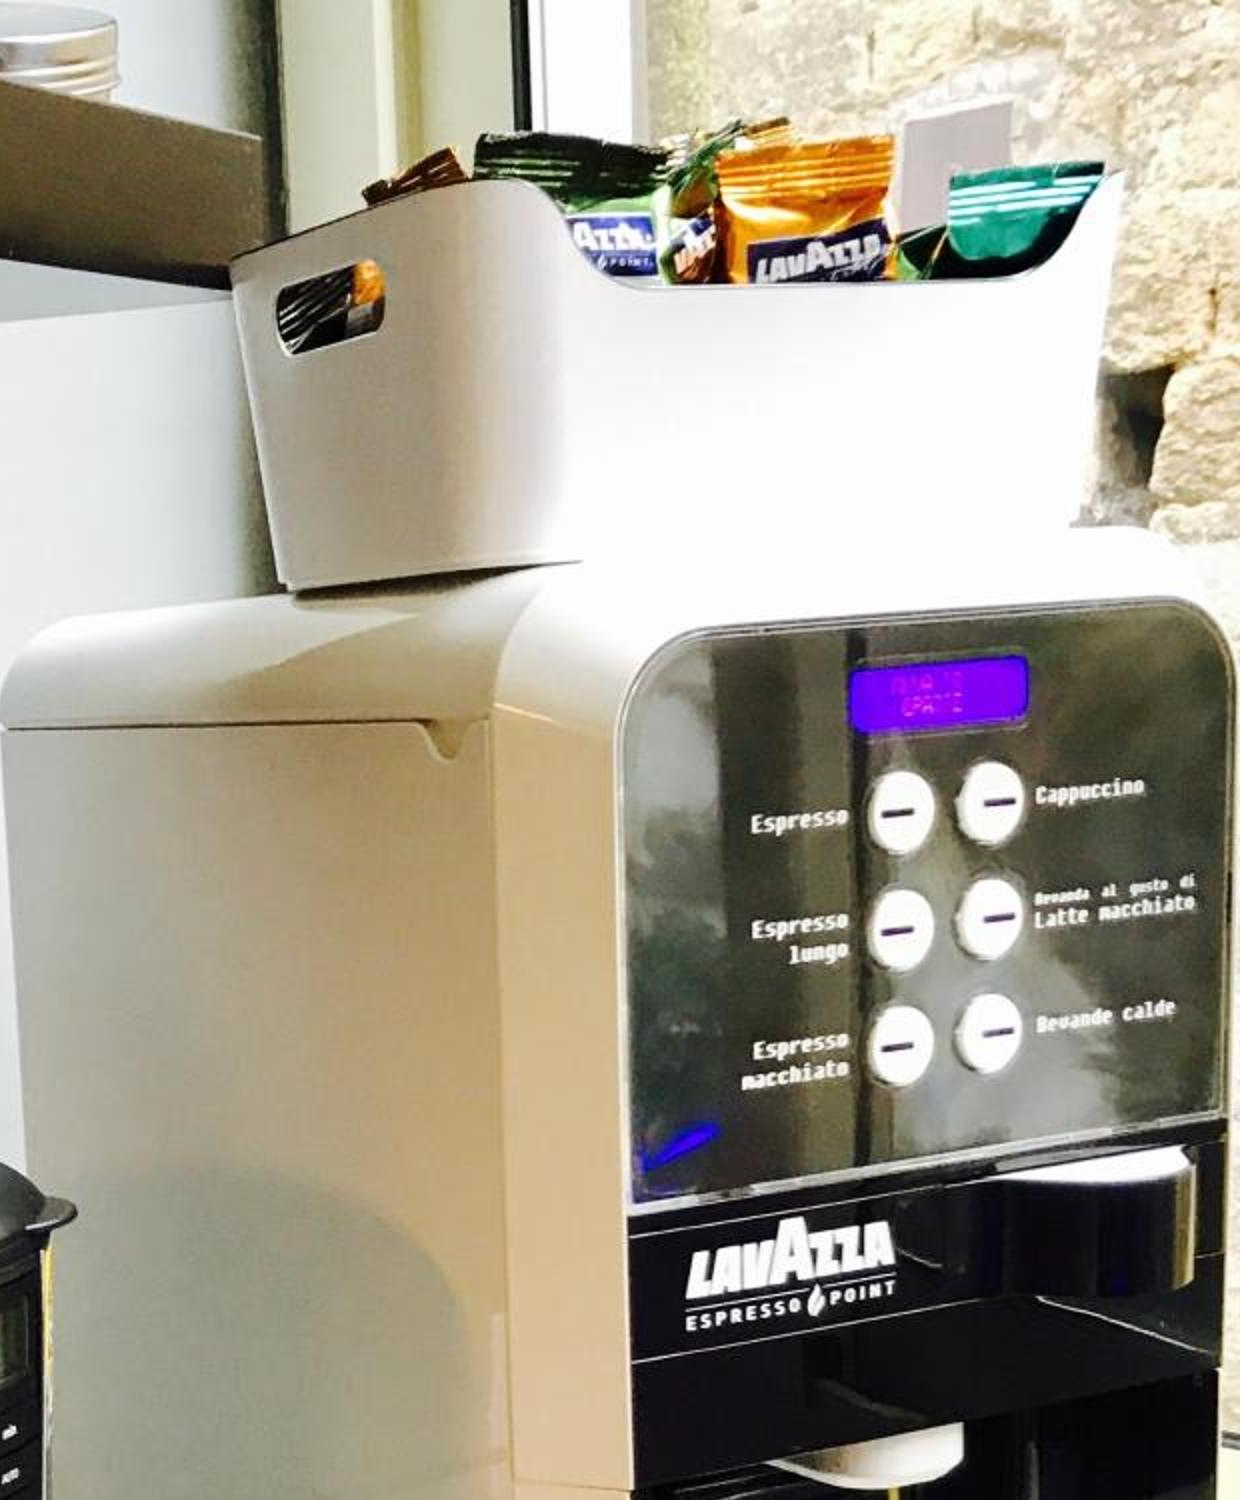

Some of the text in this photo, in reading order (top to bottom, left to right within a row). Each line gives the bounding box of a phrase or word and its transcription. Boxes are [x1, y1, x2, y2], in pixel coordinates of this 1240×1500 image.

[1035, 777, 1146, 807] Cappuccino
[751, 809, 849, 836] Espresso
[751, 913, 849, 941] Espresso
[1034, 907, 1089, 929] Latte
[789, 943, 849, 965] lungo
[1035, 999, 1177, 1033] Bevande calde
[753, 1033, 849, 1061] Espresso
[685, 1216, 896, 1300] LAVAZZA
[685, 1280, 896, 1332] ESPRESSO POINT
